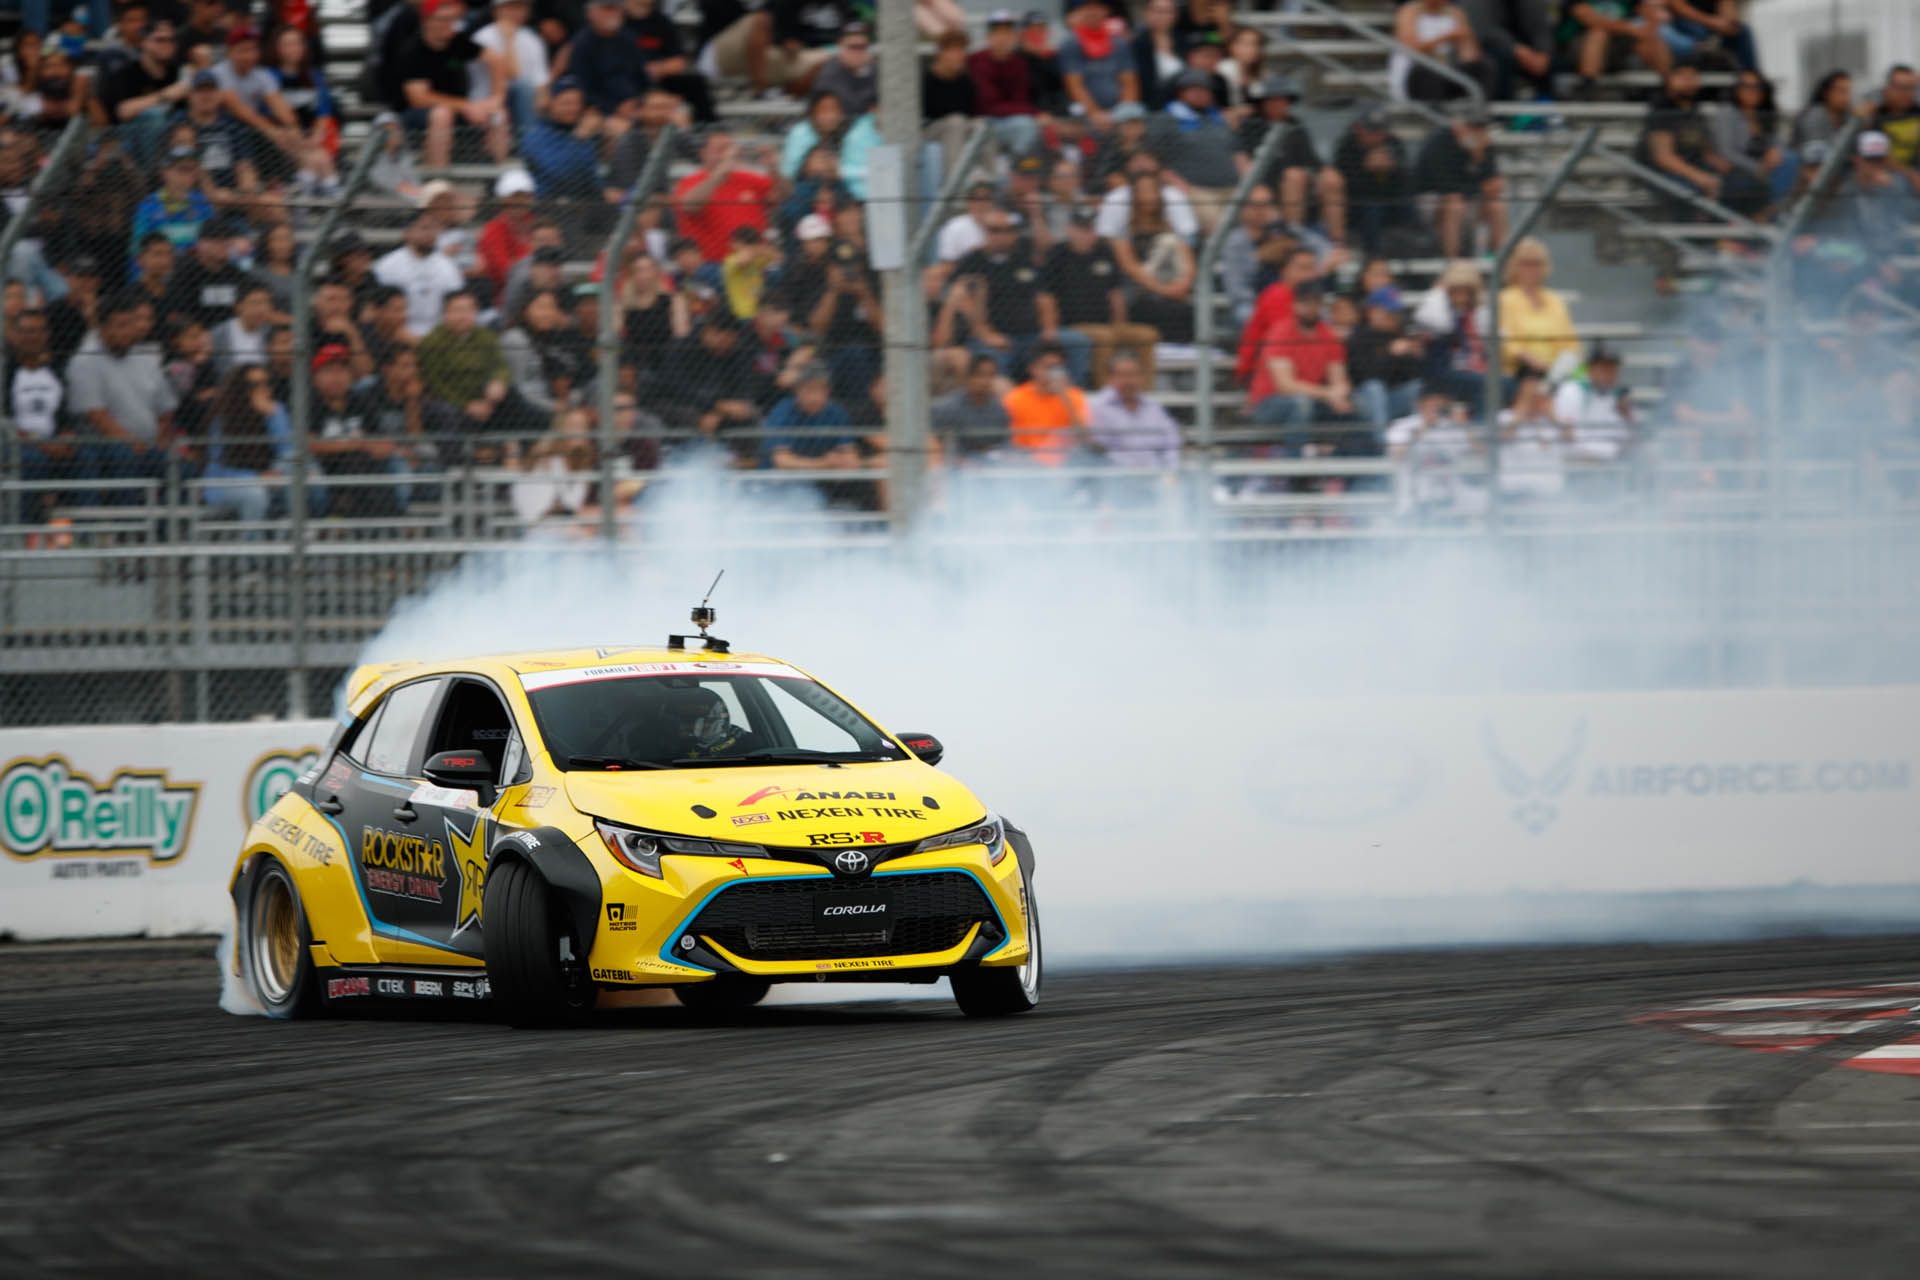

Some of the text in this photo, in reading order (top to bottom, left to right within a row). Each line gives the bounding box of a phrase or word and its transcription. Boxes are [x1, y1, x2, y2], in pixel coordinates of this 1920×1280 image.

[1588, 759, 1911, 798] AIRFORCE.COM
[795, 791, 897, 801] ANABI
[4, 770, 185, 850] O'Reilly
[776, 807, 863, 821] NEXEN
[865, 807, 928, 820] TIRE
[823, 904, 887, 916] COROLLA
[833, 960, 870, 969] NEXEN
[871, 959, 896, 967] TIRE
[592, 969, 634, 981] GATEBIL
[377, 979, 405, 994] CTEK
